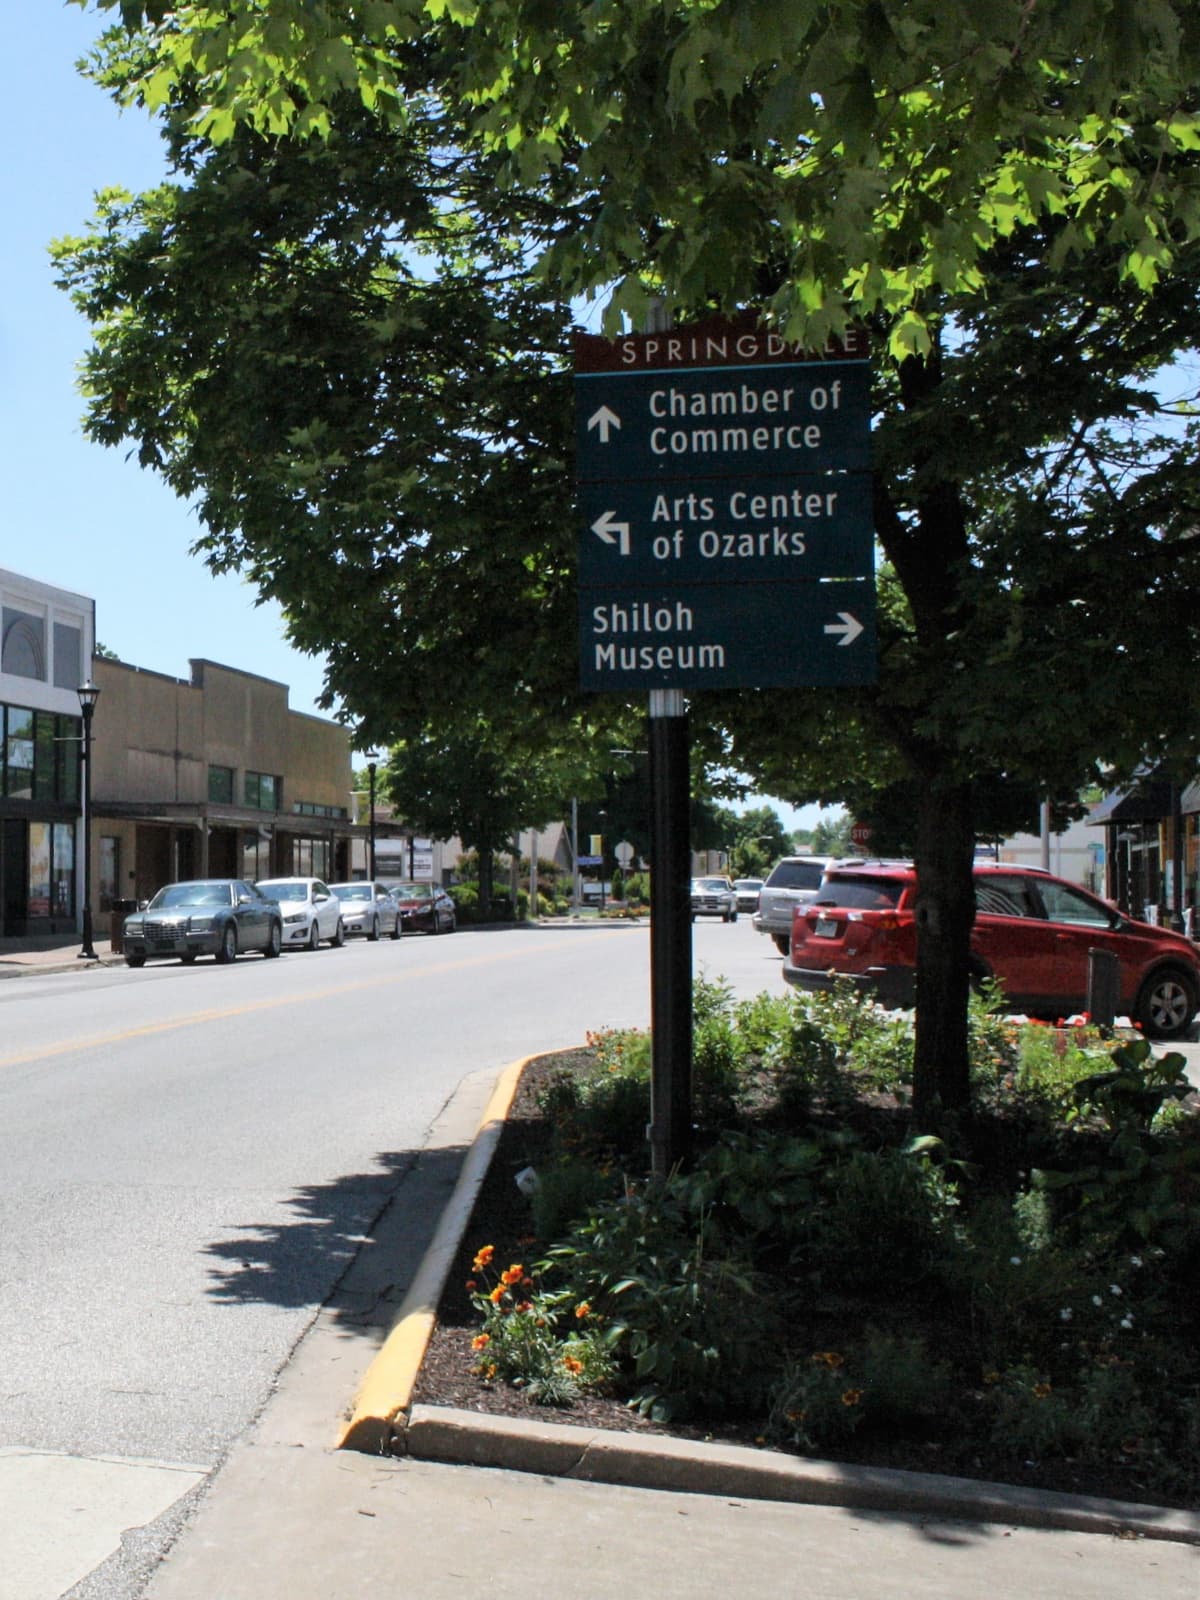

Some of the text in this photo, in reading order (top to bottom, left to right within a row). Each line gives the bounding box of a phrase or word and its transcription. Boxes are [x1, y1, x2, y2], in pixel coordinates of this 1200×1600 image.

[649, 379, 841, 417] Chamber of
[650, 424, 822, 455] Commerce
[652, 489, 838, 522] Arts Center
[652, 527, 806, 560] of Ozarks
[593, 602, 693, 634] Shiloh
[595, 643, 726, 670] Museum
[852, 828, 871, 840] STO
